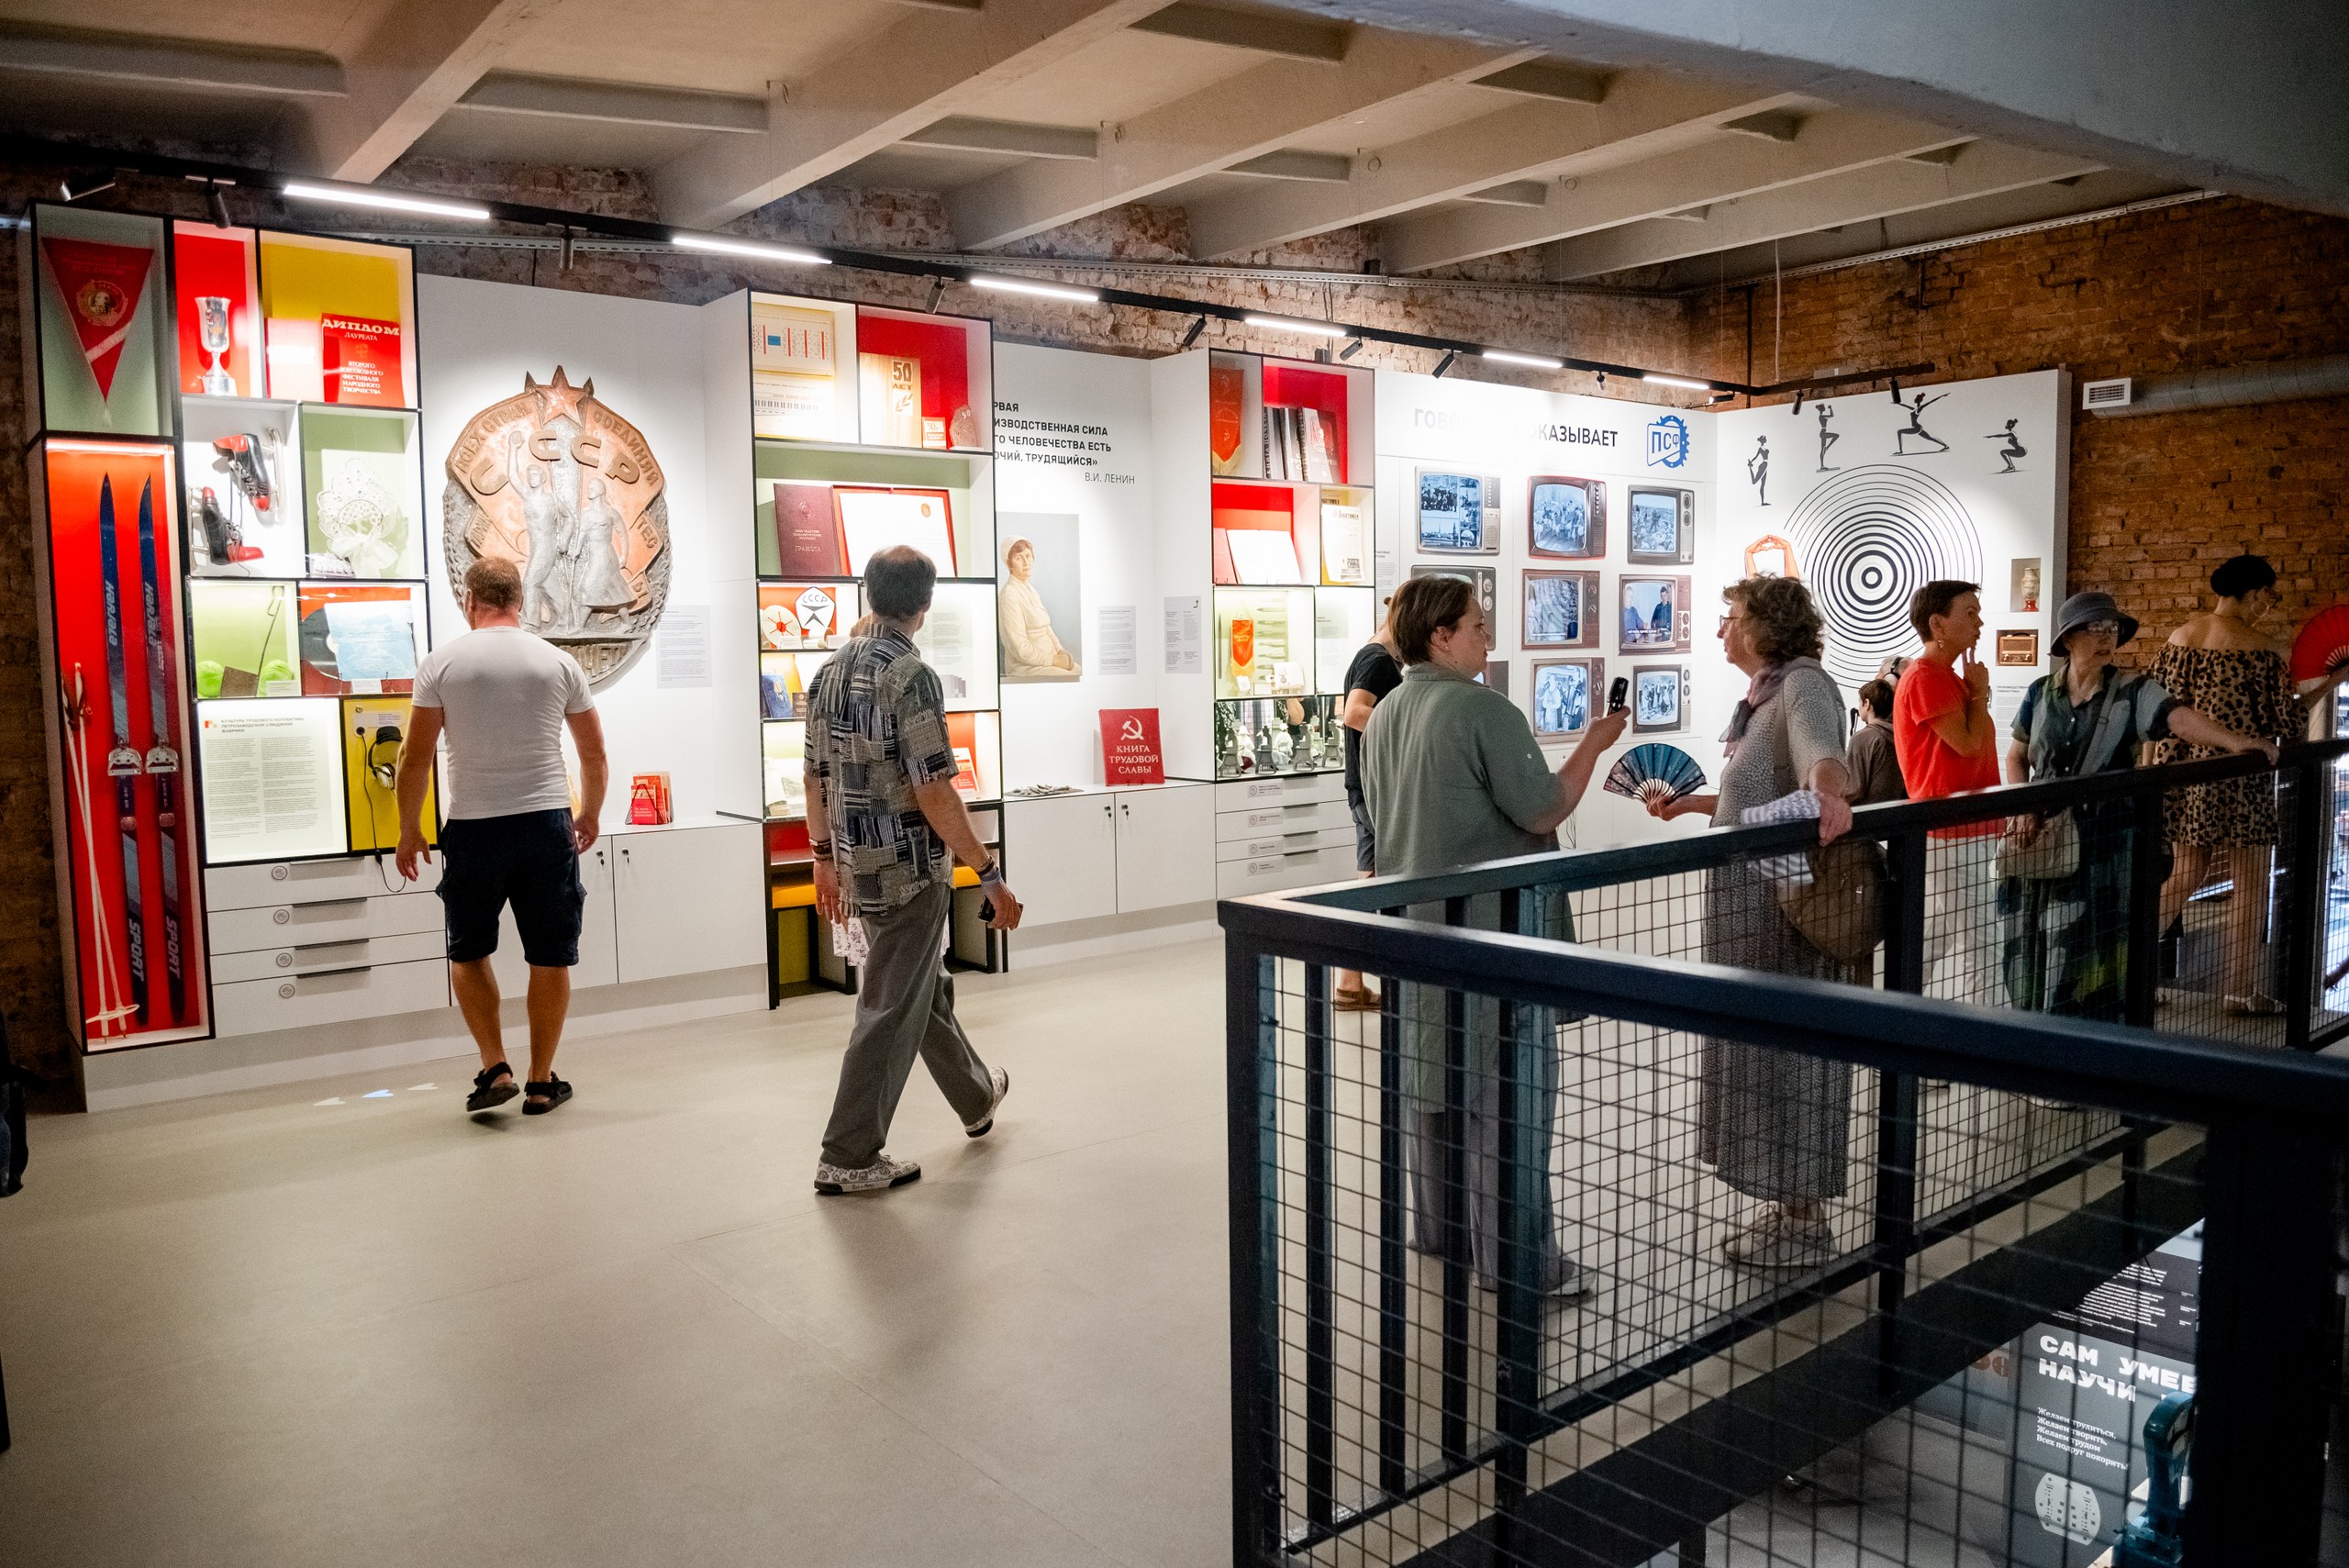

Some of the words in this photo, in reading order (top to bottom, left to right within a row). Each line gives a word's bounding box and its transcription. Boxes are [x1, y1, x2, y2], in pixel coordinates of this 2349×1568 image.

[323, 318, 400, 336] ДИПЛОМ
[345, 332, 378, 341] ЛАУРЕАТА
[349, 361, 375, 369] ВТОРОГО
[893, 361, 912, 383] 50
[342, 373, 380, 383] ФЕСТИВАЛЯ
[342, 380, 381, 389] НАРОДНОГО
[342, 386, 382, 395] ТВОРЧЕСТВА
[1082, 425, 1108, 436] СИЛА
[1008, 436, 1085, 450] ЧЕЛОВЕЧЕСТВА
[1088, 441, 1112, 452] ЕСТЬ
[1652, 431, 1680, 453] ПСФ
[470, 428, 640, 496] СССР
[1025, 452, 1098, 467] ТРУДЯЩИЙСЯ»
[1085, 472, 1102, 483] В.И.
[1104, 473, 1135, 484] ЛЕНИН
[802, 594, 828, 604] СССР
[1117, 745, 1151, 753] КНИГА
[1108, 754, 1159, 763] ТРУДОВОЙ
[1119, 765, 1152, 774] СЛАВЫ
[128, 918, 144, 983] SPORT
[165, 916, 181, 979] SPORT
[2040, 1335, 2099, 1366] САМ
[2039, 1358, 2136, 1402] НАУЧИ
[2037, 1407, 2070, 1424] Желаем
[2072, 1419, 2116, 1440] трудиться,
[2037, 1416, 2069, 1433] Желаем
[2072, 1429, 2108, 1446] творить,
[2036, 1425, 2069, 1442] Желаем
[2071, 1438, 2100, 1452] трудом
[2036, 1434, 2055, 1447] Всех
[2055, 1441, 2085, 1456] подруг
[2086, 1451, 2128, 1470] покорить!
